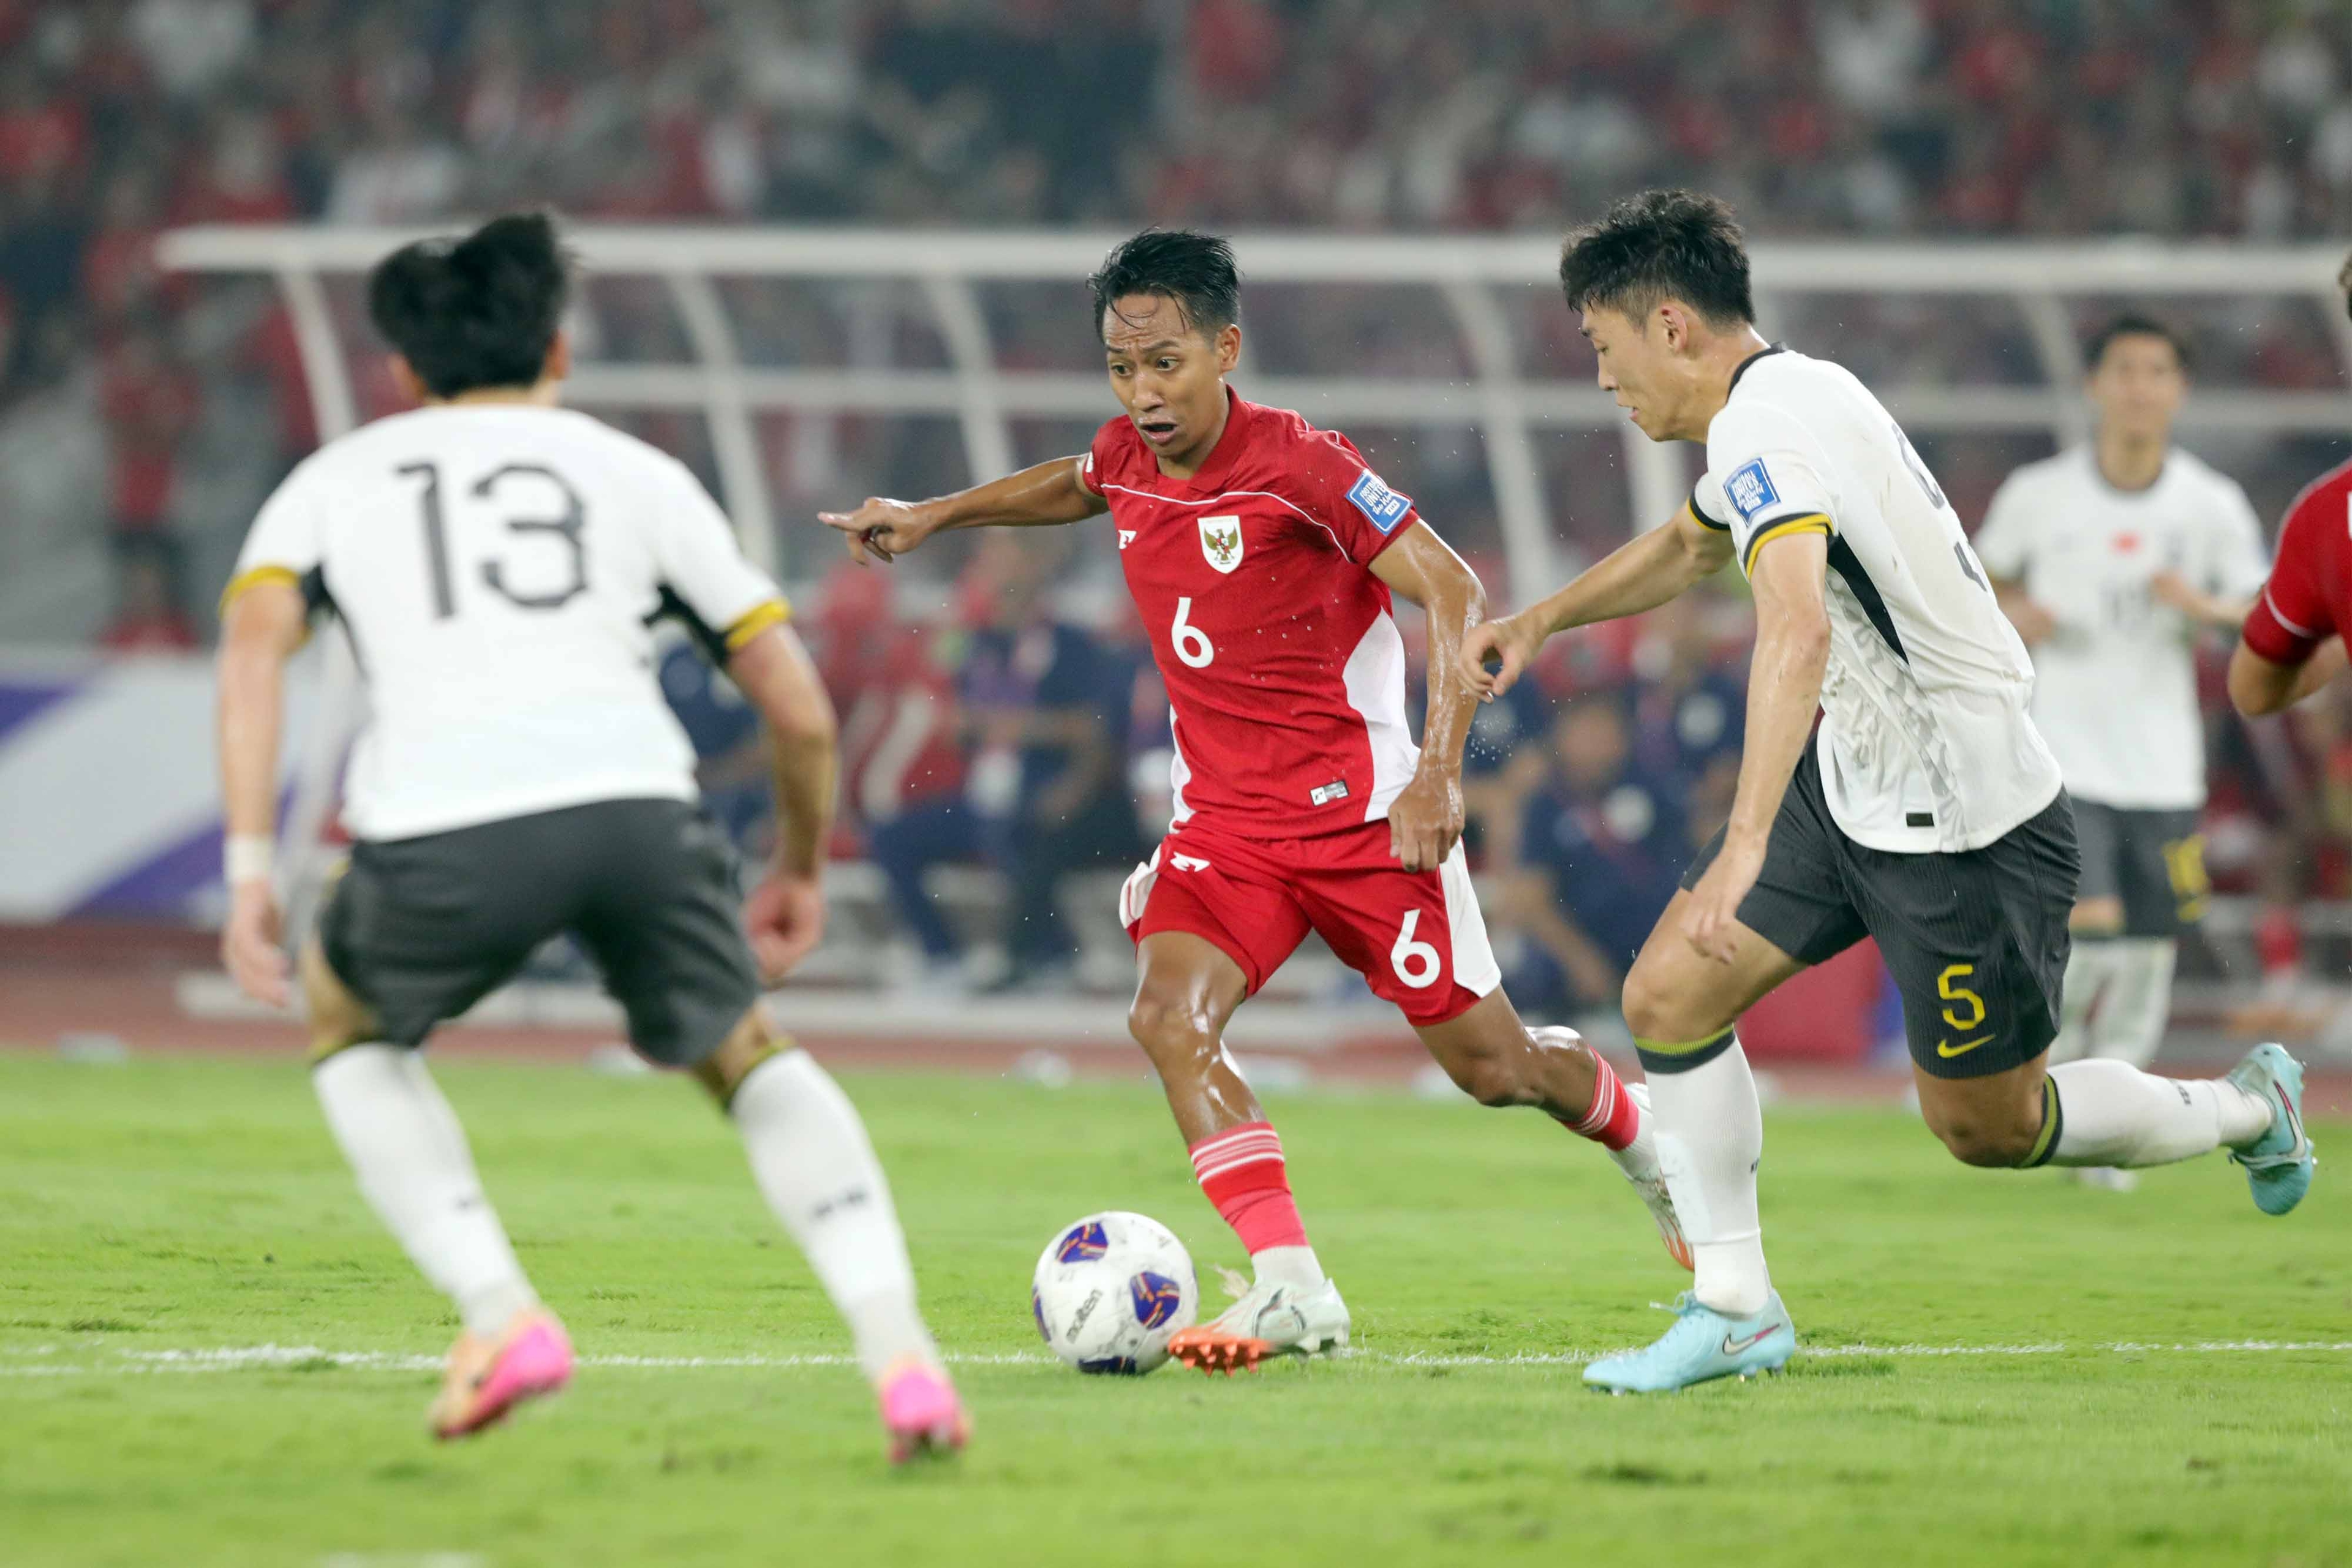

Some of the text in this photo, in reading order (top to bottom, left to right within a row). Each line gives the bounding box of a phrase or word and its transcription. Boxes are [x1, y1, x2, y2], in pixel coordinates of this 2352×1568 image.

[395, 461, 587, 619] 13
[1171, 597, 1214, 668] 6
[1390, 909, 1441, 989] 6
[1937, 964, 1985, 1030] 5
